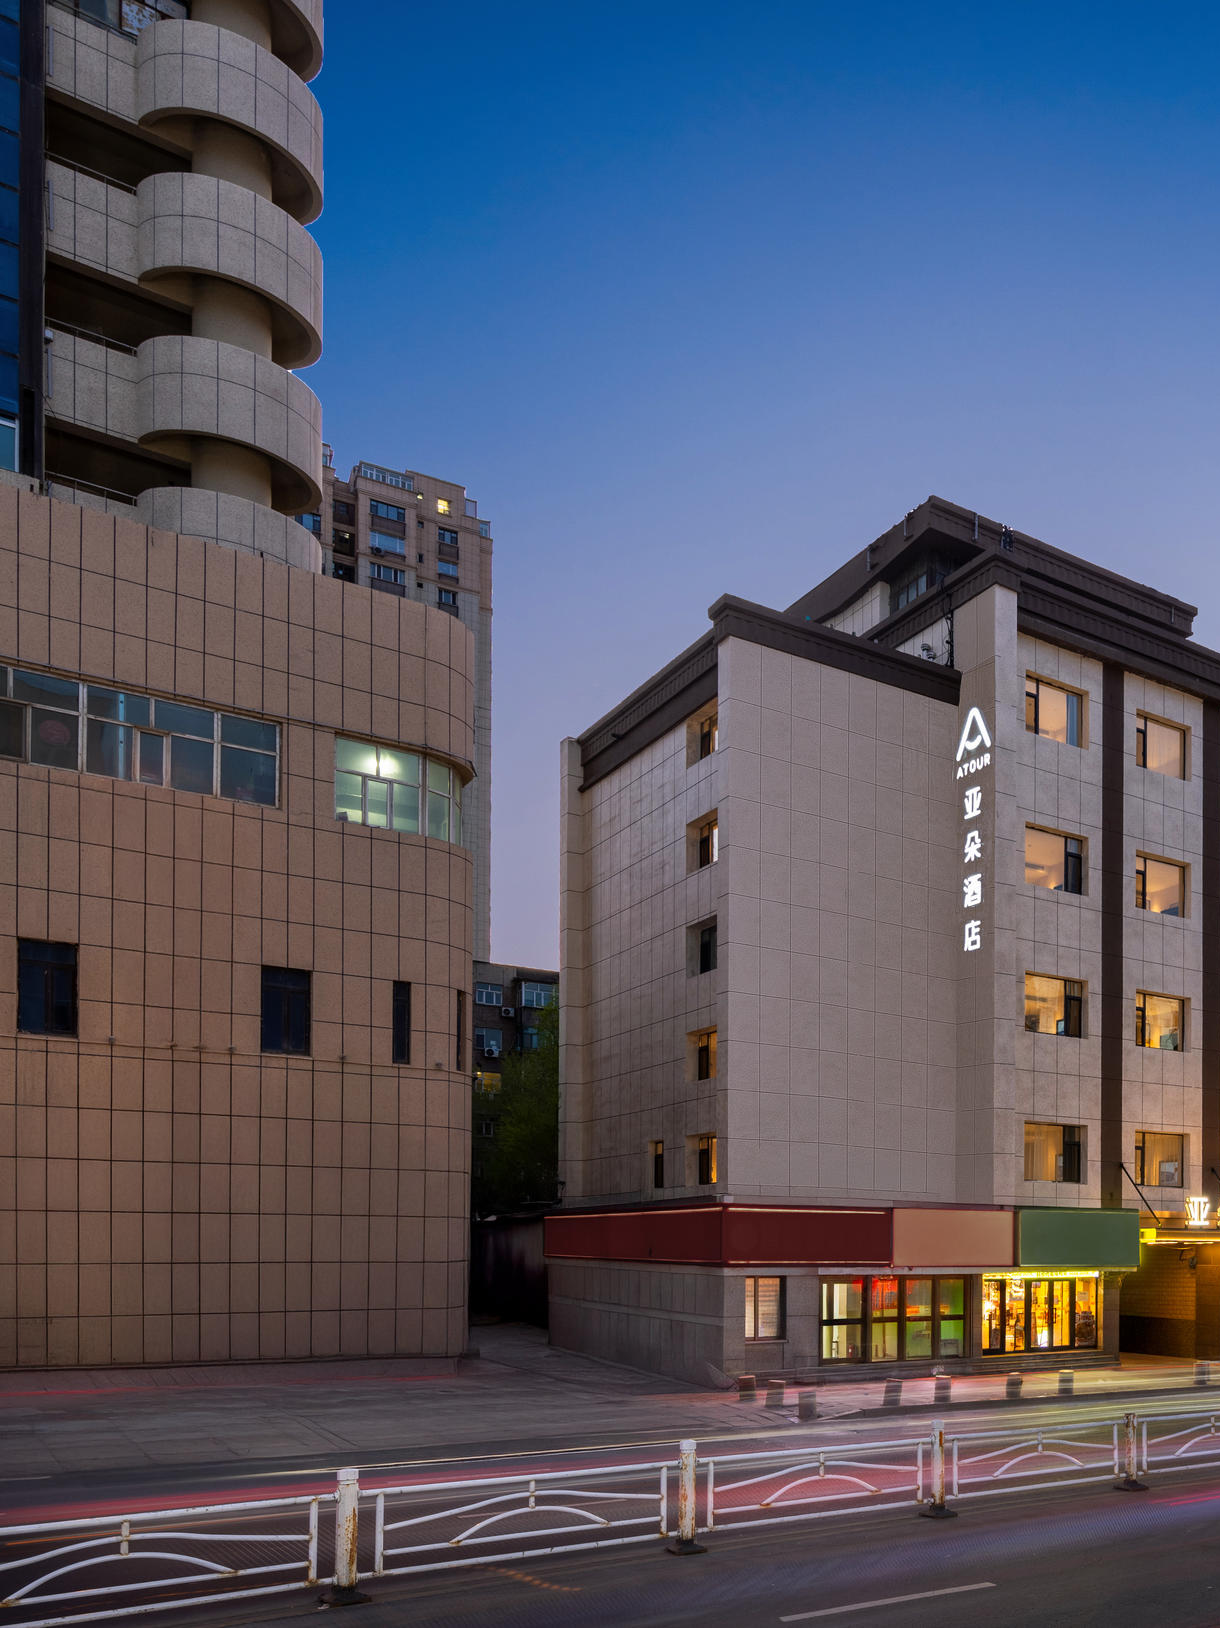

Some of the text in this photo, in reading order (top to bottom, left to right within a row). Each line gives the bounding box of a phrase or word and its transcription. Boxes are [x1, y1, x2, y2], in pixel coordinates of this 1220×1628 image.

[956, 753, 991, 780] ATOUR
[963, 786, 982, 951] 亚朵酒店
